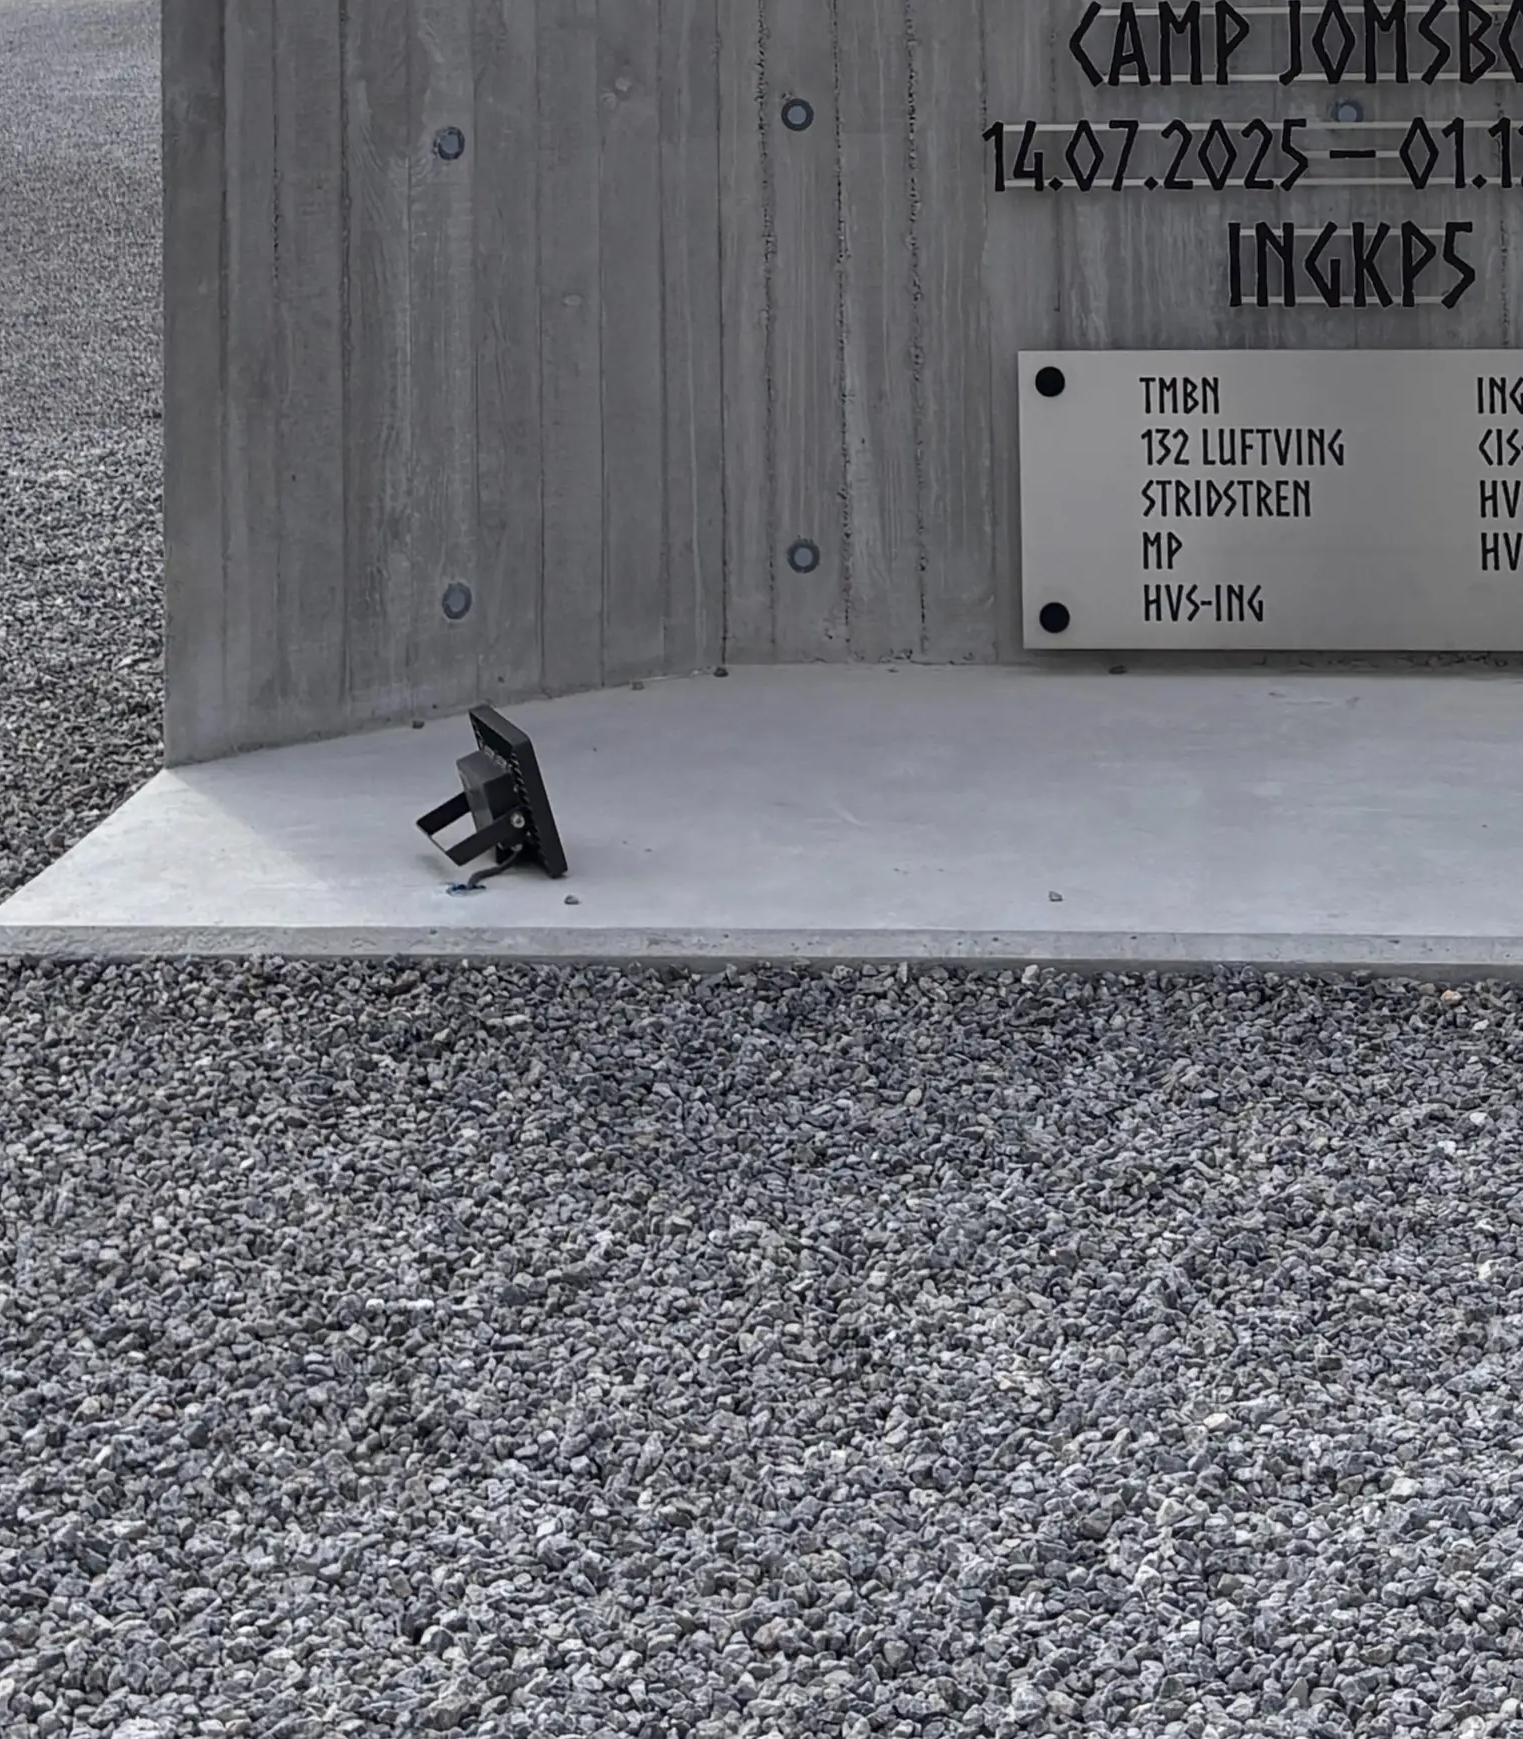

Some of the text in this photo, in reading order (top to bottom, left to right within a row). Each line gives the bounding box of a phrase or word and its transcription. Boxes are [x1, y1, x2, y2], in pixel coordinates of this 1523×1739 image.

[1069, 0, 1250, 87] CAMP
[981, 118, 1309, 192] 14.07.2025
[1228, 220, 1476, 309] INGKPS
[1139, 376, 1220, 415] TMBN
[1140, 428, 1344, 466] 132 LUFTVING
[1141, 479, 1311, 518] STRIDSTREN
[1142, 531, 1183, 570] MP
[1143, 584, 1264, 622] HVS-ING
